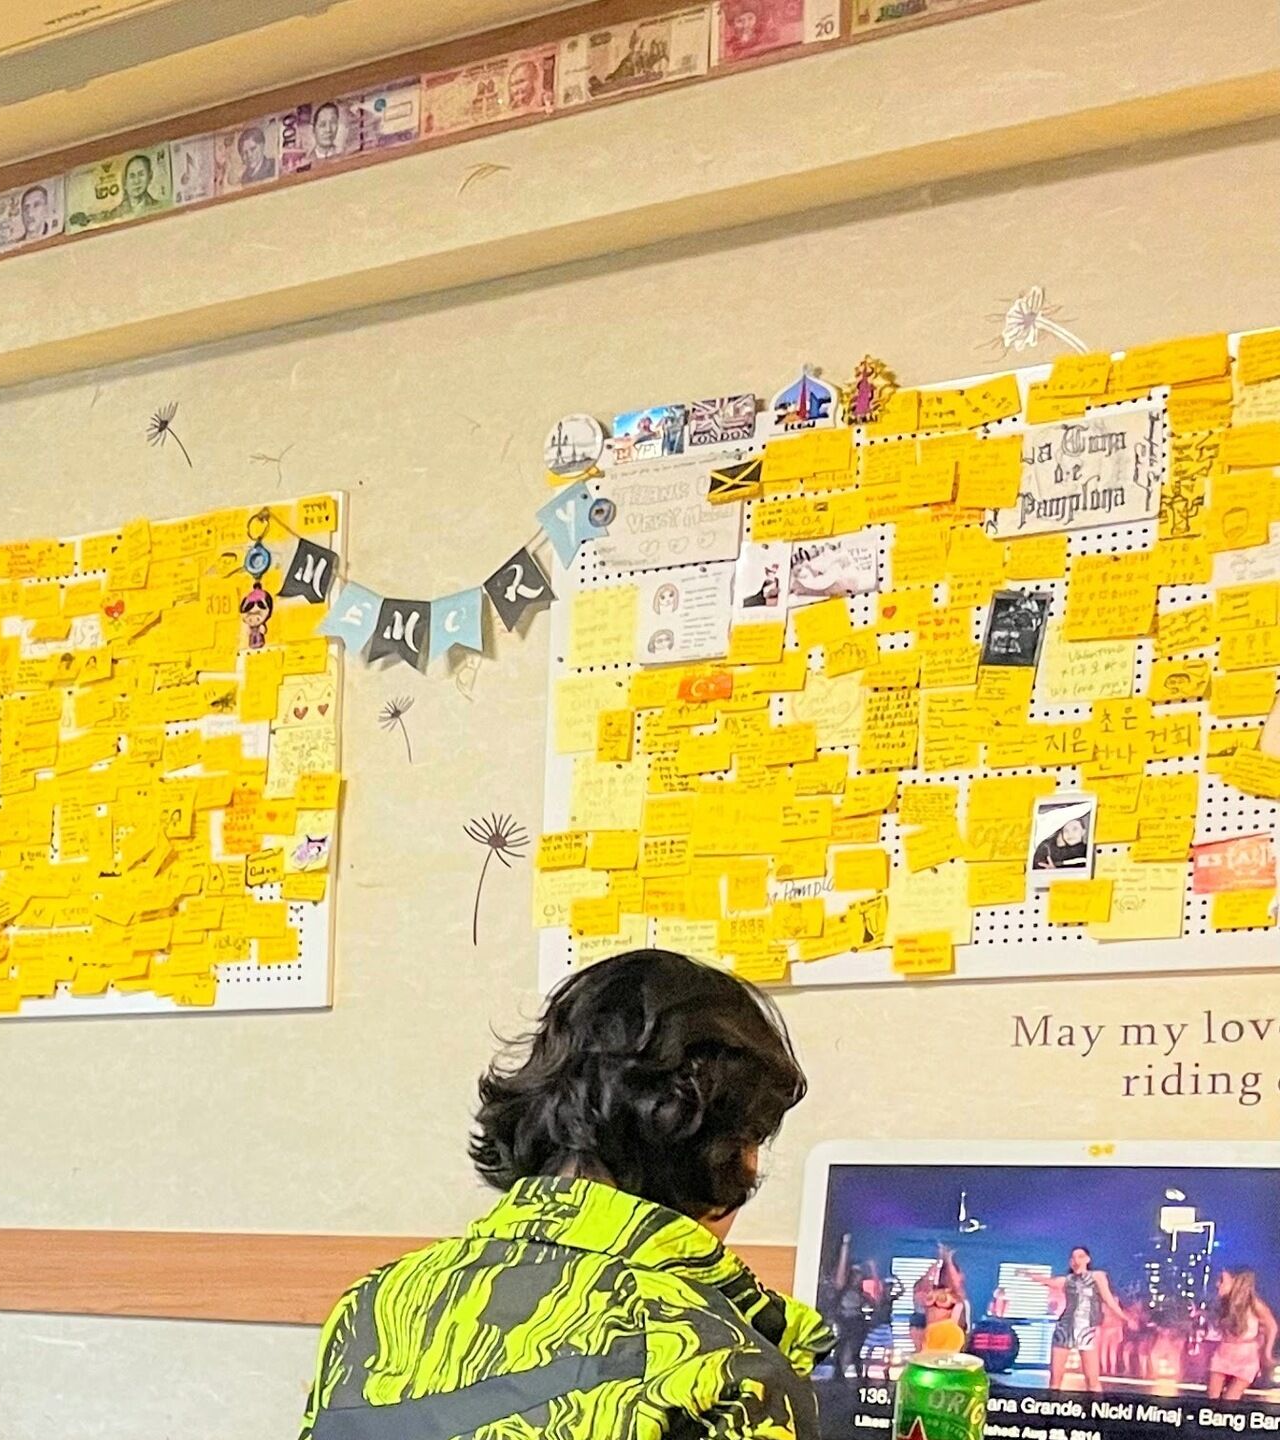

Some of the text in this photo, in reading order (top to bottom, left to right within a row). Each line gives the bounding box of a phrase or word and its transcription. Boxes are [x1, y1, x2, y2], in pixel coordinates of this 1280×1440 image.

[815, 20, 834, 38] 20
[282, 114, 296, 147] 100
[692, 429, 752, 446] LONDON
[1045, 727, 1088, 753] 지은
[1011, 1010, 1280, 1057] May my lov
[1122, 1062, 1262, 1106] riding
[858, 1386, 892, 1405] 136.
[987, 1398, 1018, 1413] ana
[1020, 1397, 1086, 1419] Grande,
[1091, 1403, 1132, 1421] Nicki
[1137, 1405, 1182, 1427] Minaj
[1199, 1408, 1246, 1432] Bang
